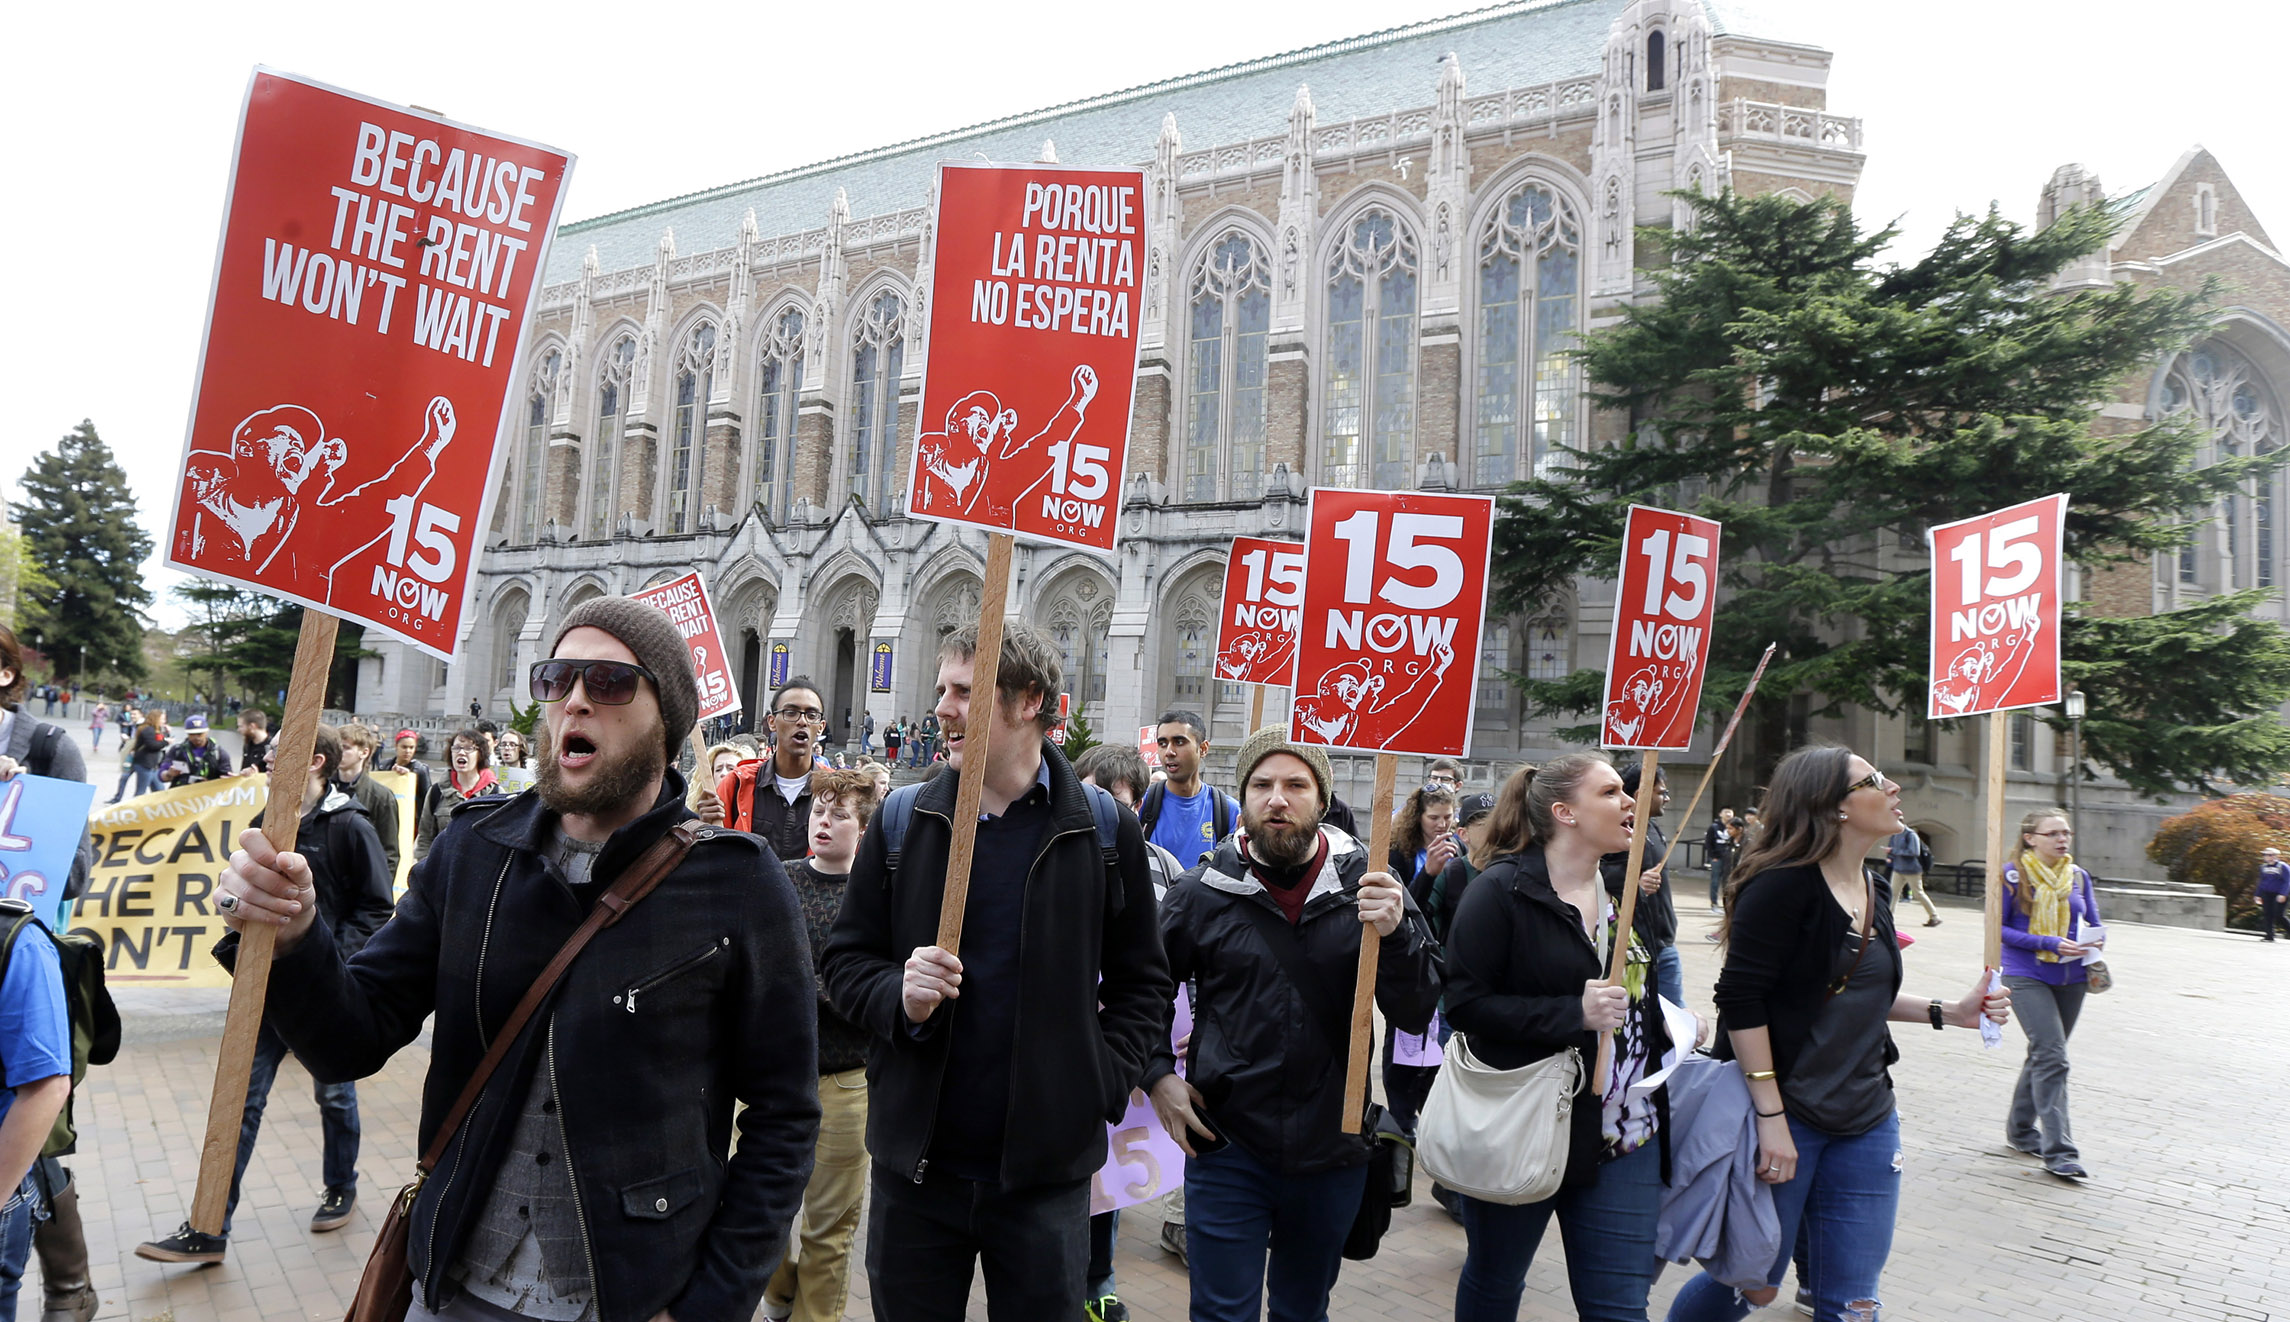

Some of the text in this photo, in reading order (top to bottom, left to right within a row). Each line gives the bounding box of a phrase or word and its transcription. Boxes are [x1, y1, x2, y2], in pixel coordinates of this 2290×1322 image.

[350, 121, 545, 232] BECAUSE
[1022, 182, 1136, 234] PORQUE
[330, 186, 527, 300] THE RENT
[991, 232, 1135, 287] LA RENTA
[261, 237, 511, 368] WON'T WAIT
[971, 279, 1129, 339] NO ESPERA
[1047, 440, 1110, 501] 15
[385, 494, 462, 583] 15
[1042, 495, 1106, 529] NOW
[1241, 549, 1304, 606] 15
[1334, 510, 1465, 610] 15
[1641, 529, 1709, 621] 15
[1951, 515, 2043, 606] 15
[370, 565, 450, 622] NOW
[669, 597, 705, 624] RENT
[1951, 592, 2042, 643] NOW
[1324, 608, 1460, 657] NOW
[1629, 620, 1703, 662] NOW
[697, 670, 726, 699] 15
[773, 654, 783, 686] Welcome
[875, 654, 886, 689] Welcome
[701, 690, 728, 710] NOW
[144, 786, 256, 821] MINIMUM
